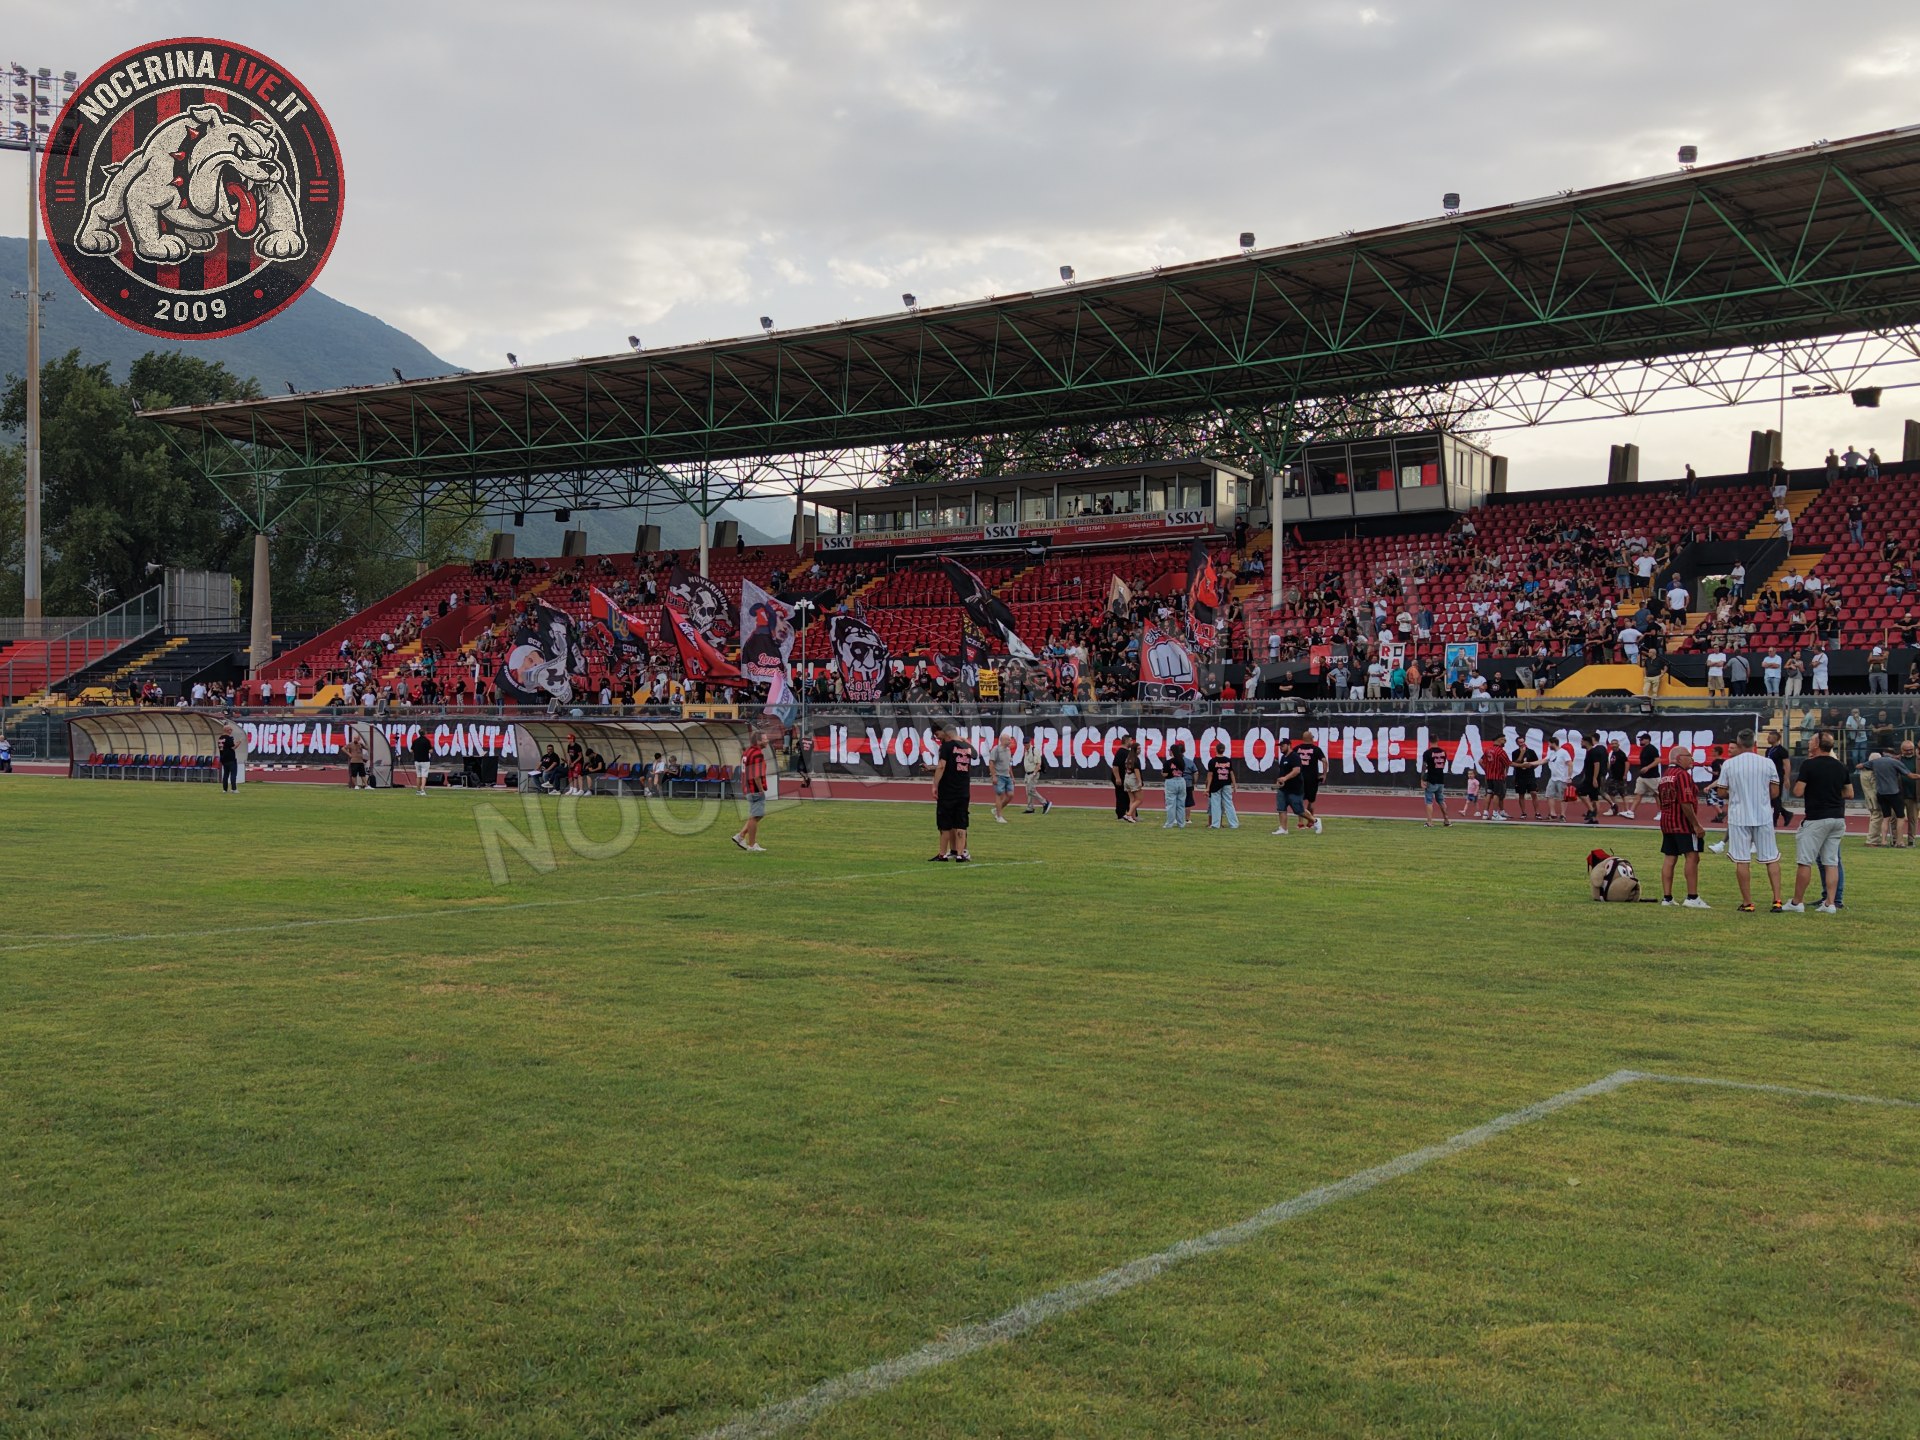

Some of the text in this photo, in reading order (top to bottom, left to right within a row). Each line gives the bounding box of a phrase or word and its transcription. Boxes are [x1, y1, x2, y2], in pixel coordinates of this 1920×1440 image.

[1312, 655, 1349, 664] ALERTO
[238, 723, 305, 755] DIERE
[308, 722, 340, 755] AL
[434, 723, 518, 758] CANTA
[829, 724, 860, 765] IL
[1034, 725, 1231, 771] RICORDO
[1417, 724, 1486, 775] LA
